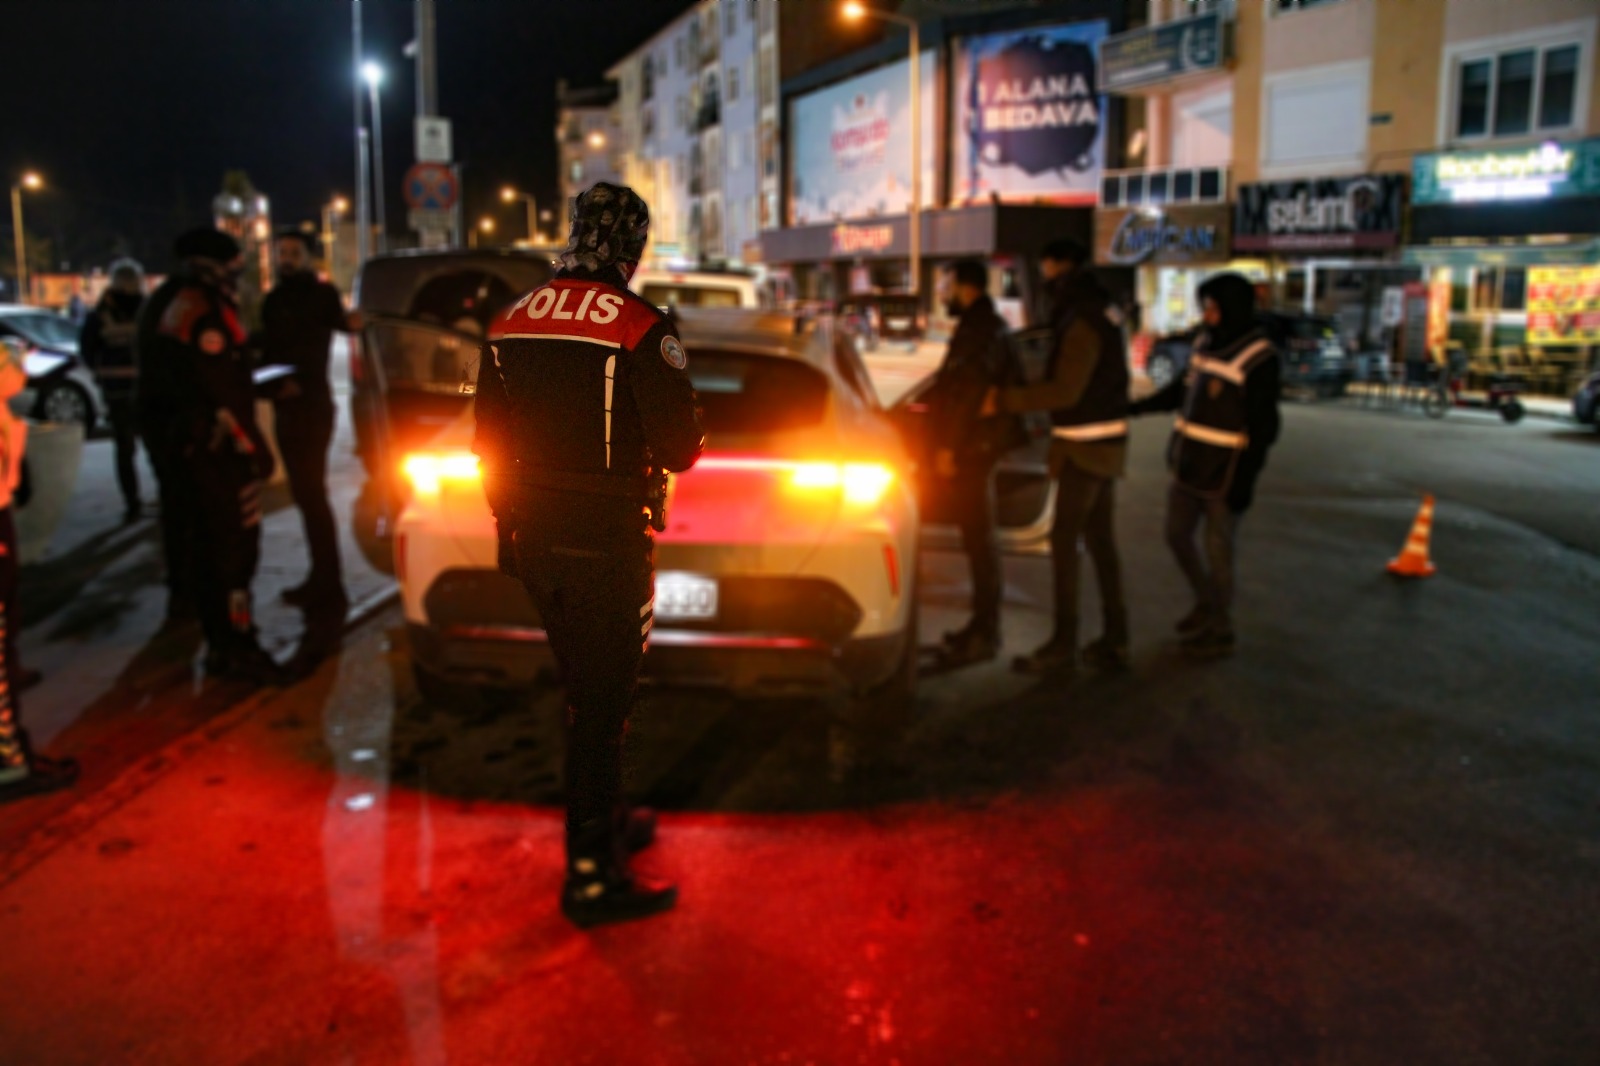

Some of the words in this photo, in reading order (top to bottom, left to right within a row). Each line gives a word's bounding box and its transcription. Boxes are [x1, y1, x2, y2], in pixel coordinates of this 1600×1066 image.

[994, 73, 1089, 103] ALANA
[985, 98, 1098, 131] BEDAVA
[507, 286, 625, 324] POLİS
